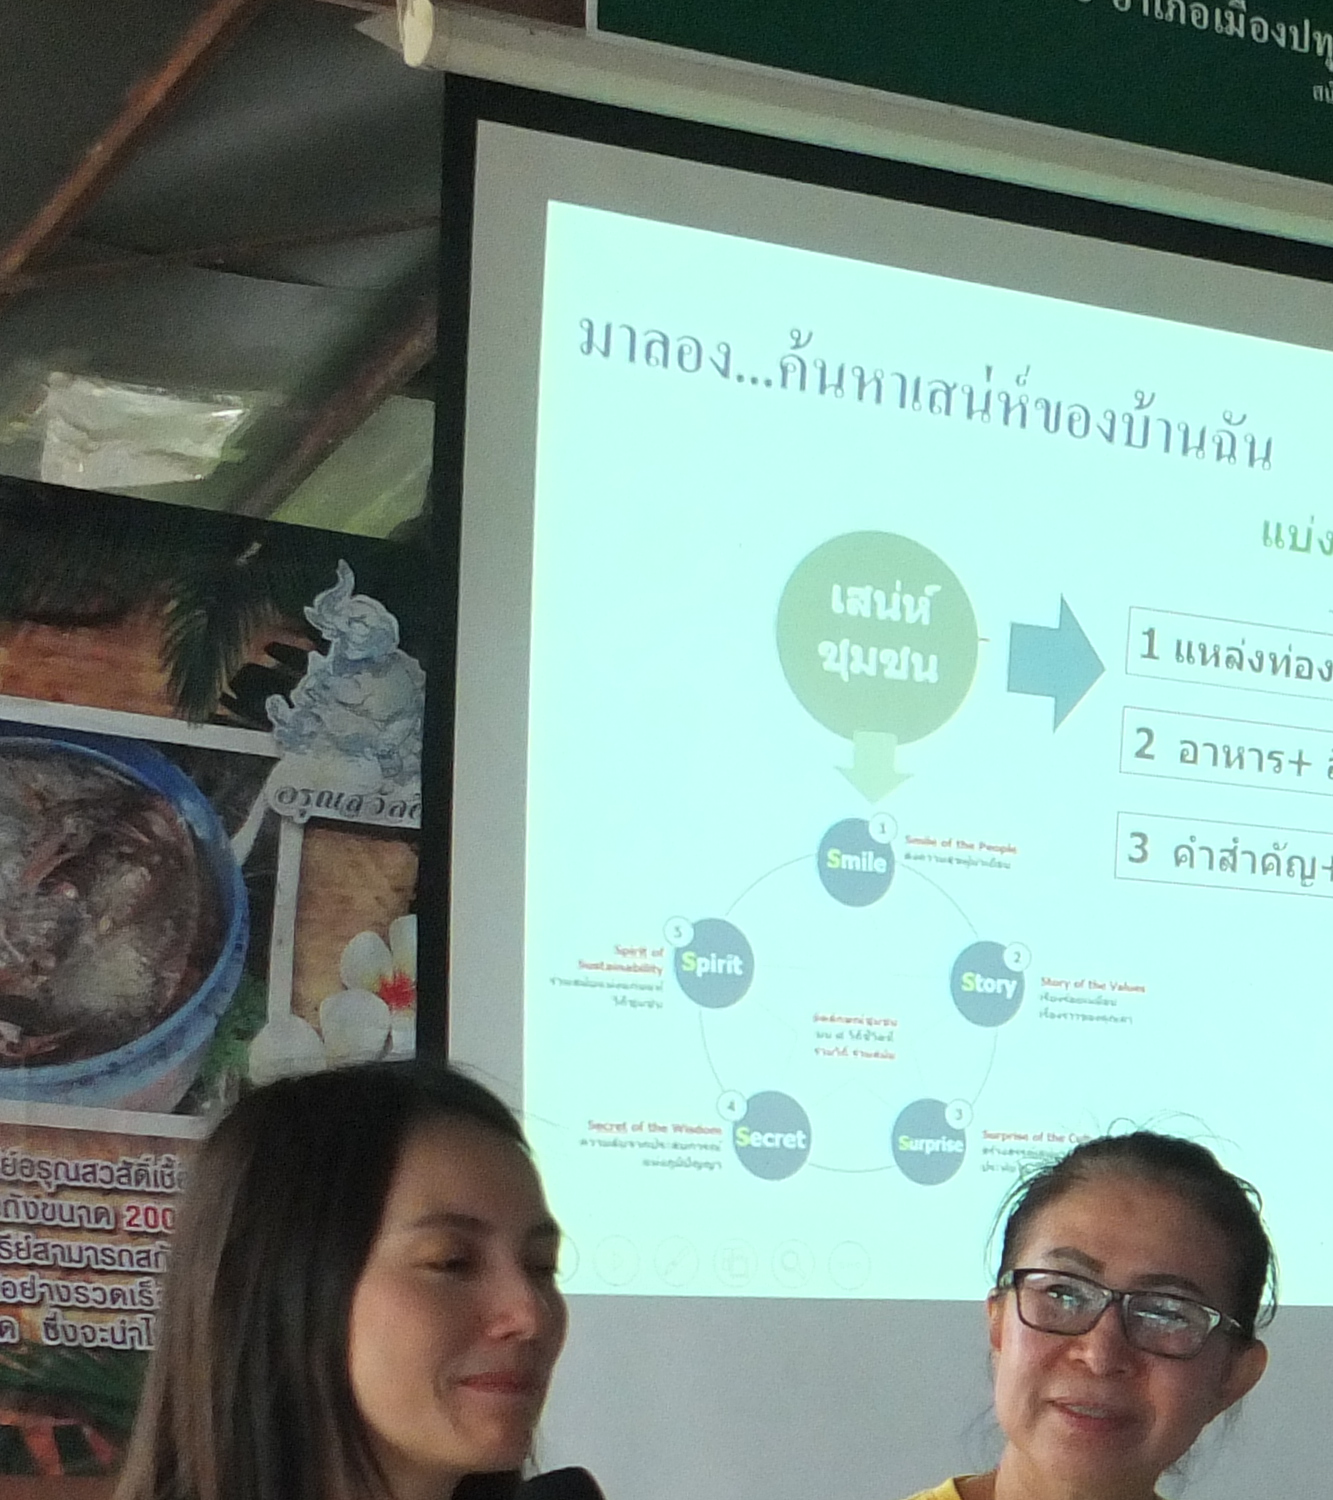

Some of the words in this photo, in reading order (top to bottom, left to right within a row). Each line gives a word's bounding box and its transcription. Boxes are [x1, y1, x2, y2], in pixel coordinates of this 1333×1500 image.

[1139, 627, 1161, 661] 1
[817, 638, 940, 685] ชุมชน
[1134, 727, 1156, 761] 2
[827, 848, 888, 873] Smile
[1127, 832, 1150, 865] 3
[681, 950, 744, 977] Spirit
[961, 971, 1018, 1000] Story
[588, 1120, 628, 1134] Secret
[631, 1121, 644, 1132] of
[648, 1122, 668, 1133] the
[672, 1123, 723, 1136] Wisdom
[735, 1126, 807, 1150] Secret
[899, 1135, 964, 1155] Surprise
